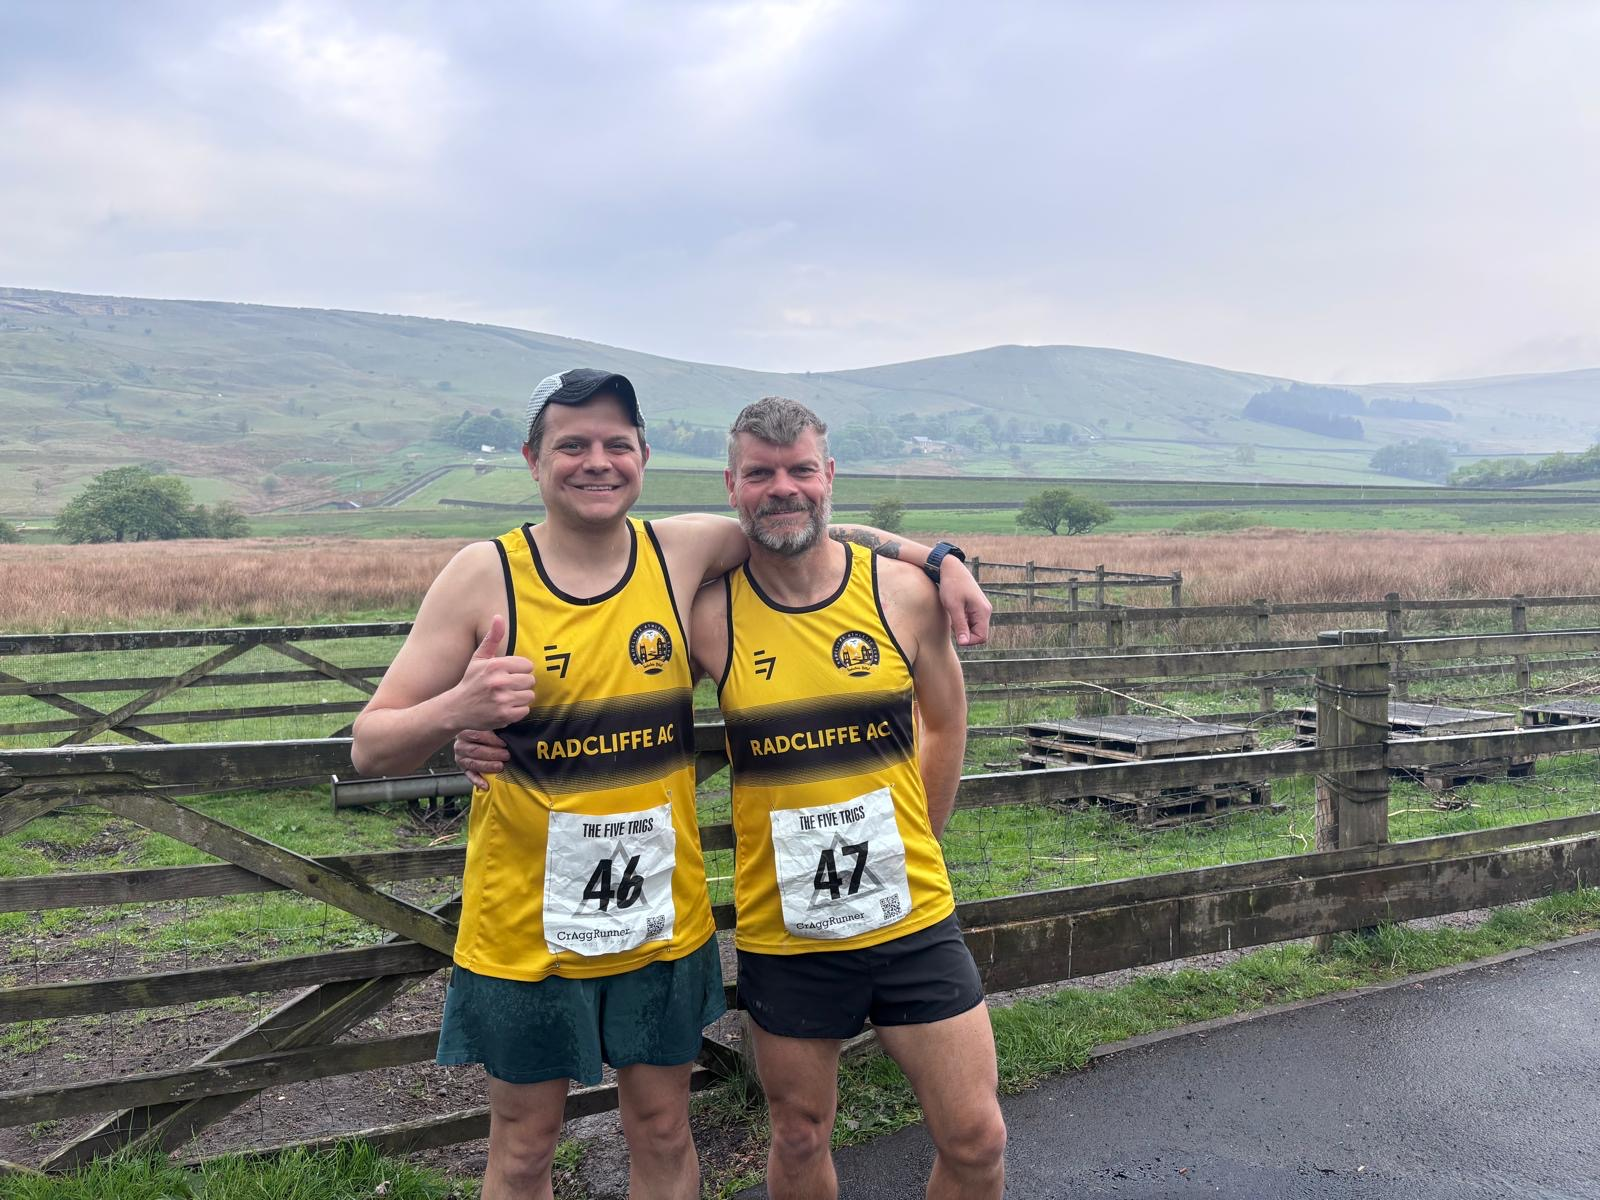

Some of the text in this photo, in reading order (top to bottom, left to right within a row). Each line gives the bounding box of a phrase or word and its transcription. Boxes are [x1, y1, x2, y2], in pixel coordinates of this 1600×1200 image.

[536, 723, 674, 760] RADCLIFFE AC
[749, 720, 891, 756] RADCLIFFE AC
[583, 817, 654, 838] THE FIVE TRIGS
[799, 805, 866, 831] THE FIVE TRIGS
[583, 854, 645, 912] 46
[813, 840, 869, 900] 47
